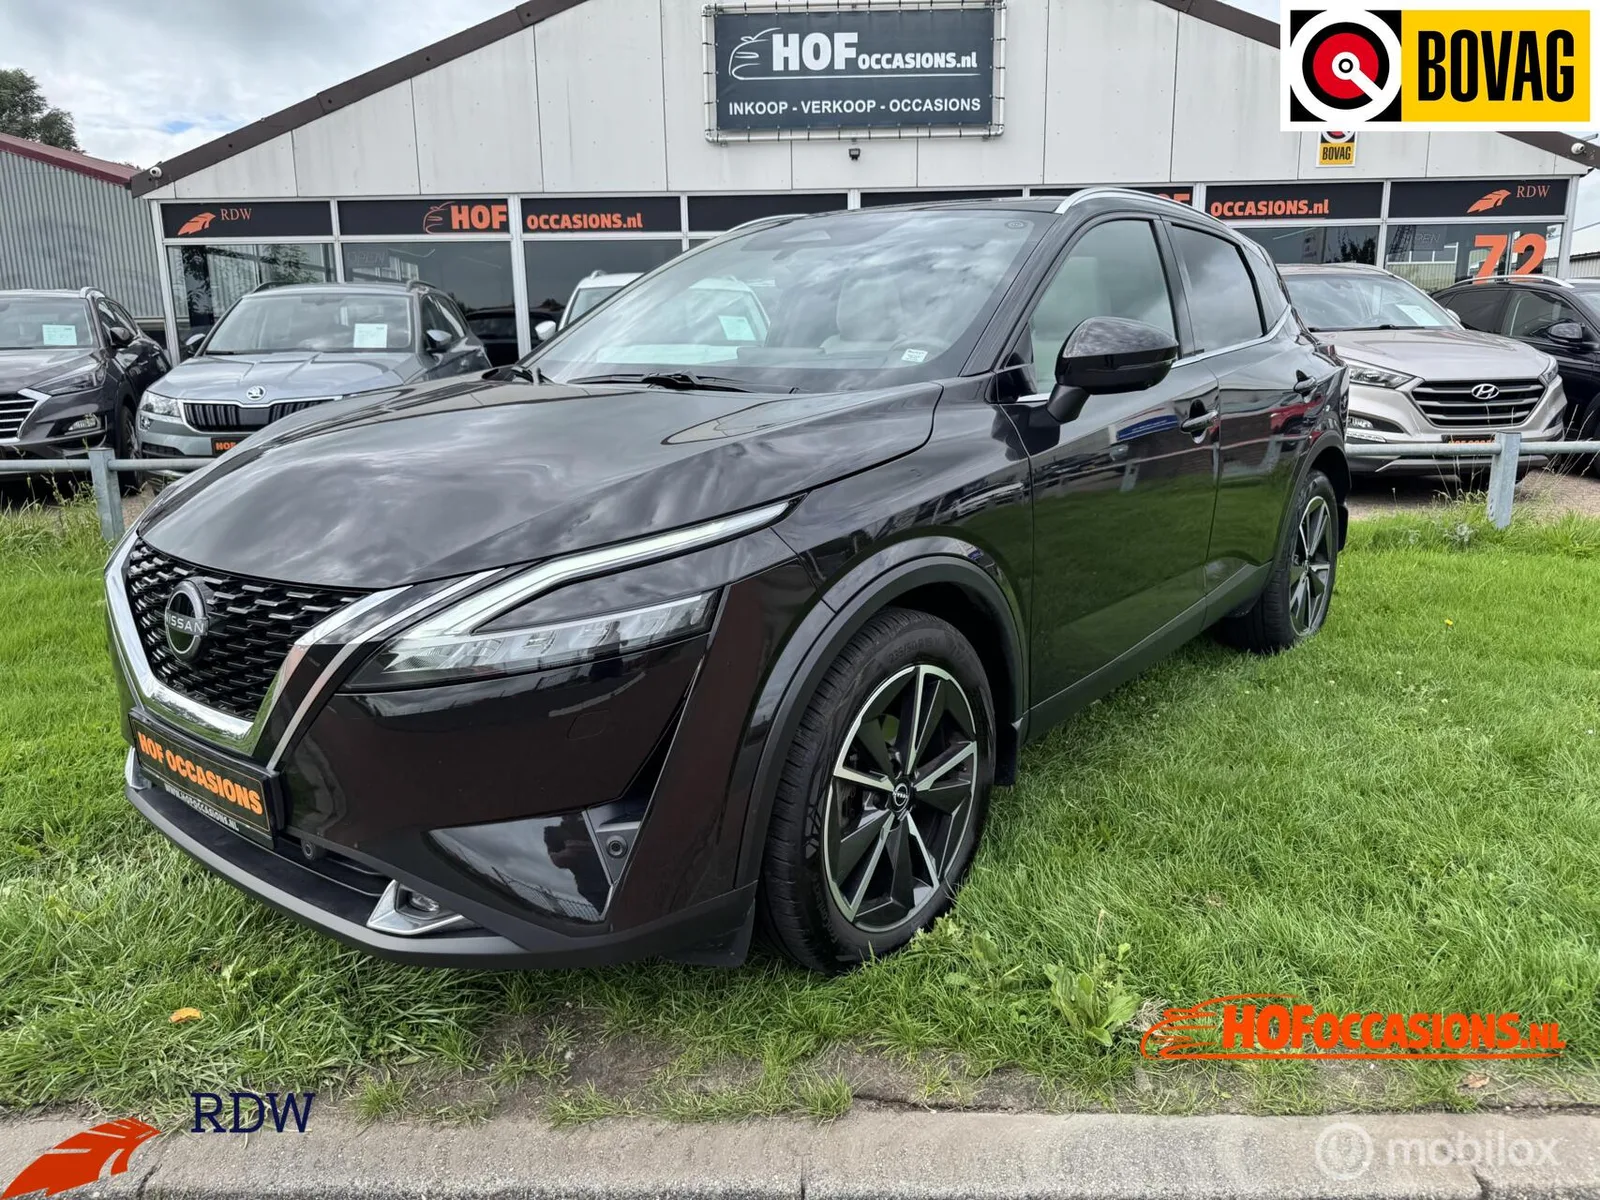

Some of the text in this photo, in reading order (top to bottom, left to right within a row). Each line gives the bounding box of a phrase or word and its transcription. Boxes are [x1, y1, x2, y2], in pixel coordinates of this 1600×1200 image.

[728, 101, 788, 116] INKOOP
[801, 100, 877, 114] VERKOOP
[889, 98, 981, 113] OCCASIONS
[1322, 146, 1352, 161] BOVAG
[1516, 185, 1551, 198] RDW
[220, 208, 252, 221] RDW
[1210, 198, 1330, 217] OCCASIONS.nl
[451, 204, 644, 231] HOF OCCASIONS.nl
[1472, 233, 1547, 285] 72
[137, 731, 263, 815] HOF OCCASIONS
